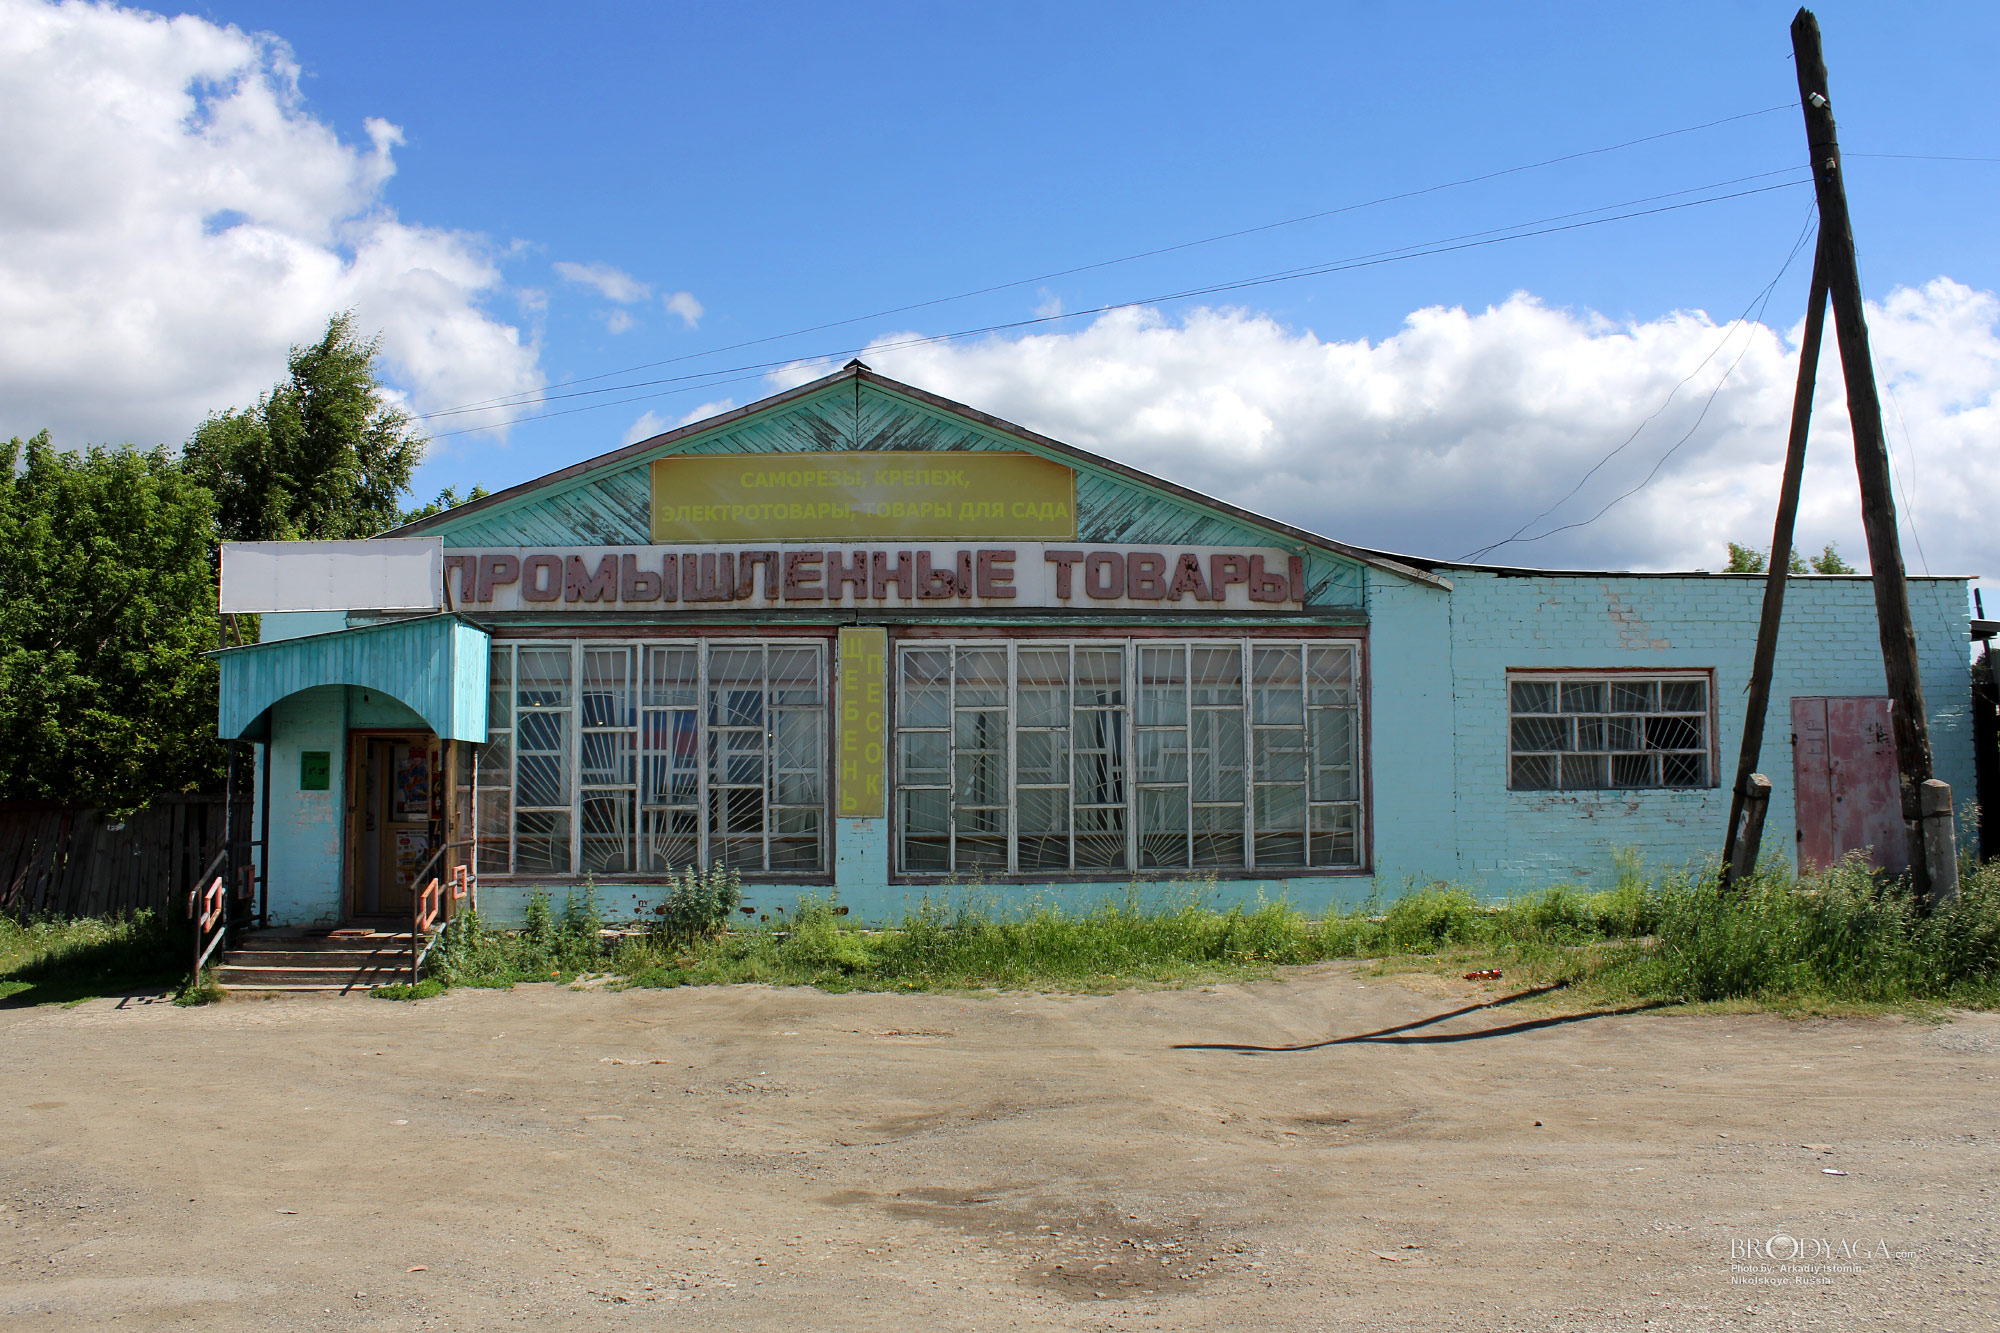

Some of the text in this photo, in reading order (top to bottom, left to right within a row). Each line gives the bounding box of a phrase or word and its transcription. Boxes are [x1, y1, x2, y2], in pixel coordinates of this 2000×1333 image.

[740, 469, 970, 488] САМОРЕЗЫ, КРЕПЕЖ,
[661, 501, 1069, 522] ЭЛЕКТРОТОВАРЫ, ТОВАРЫ ДЛЯ САДА
[444, 550, 1306, 604] ПРОМЫШЛЕННЫЕ ТОВАРЫ
[842, 636, 864, 811] ЩЕБЕНЬ
[864, 653, 883, 796] ПЕСОК
